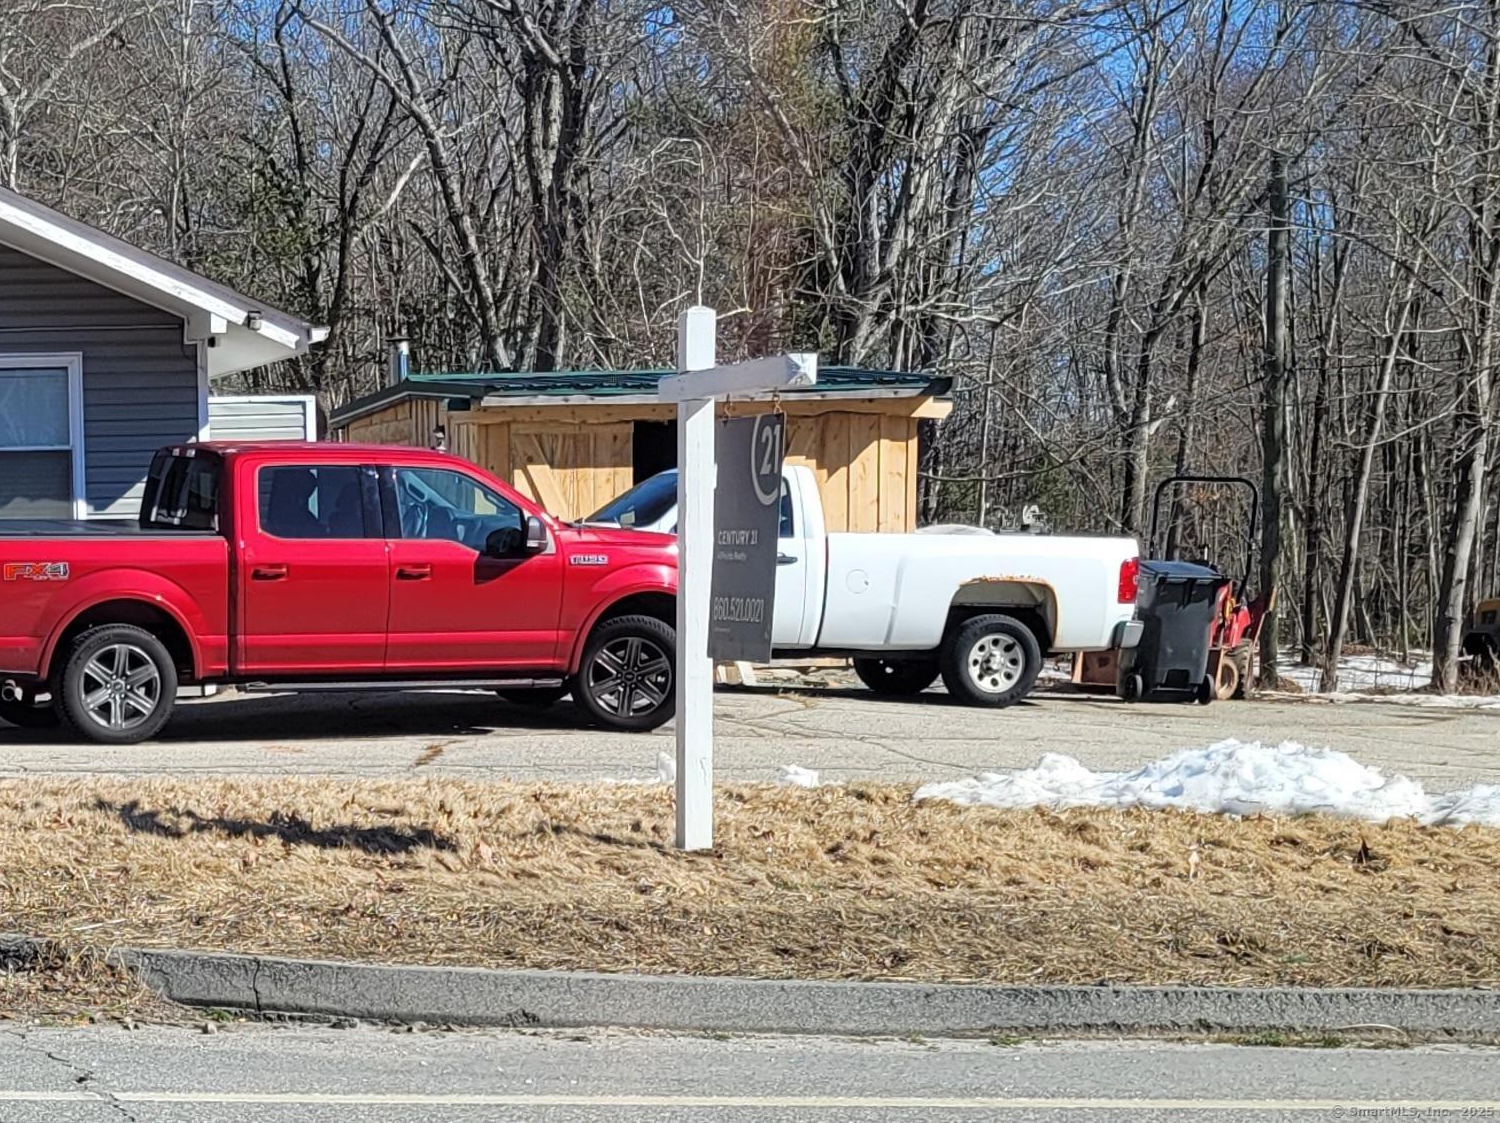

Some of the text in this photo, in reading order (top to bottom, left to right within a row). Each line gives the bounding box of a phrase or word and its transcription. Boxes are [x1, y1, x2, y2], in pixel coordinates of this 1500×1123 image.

[759, 424, 781, 475] 21
[717, 530, 749, 545] CENTURY
[3, 562, 69, 581] FX4
